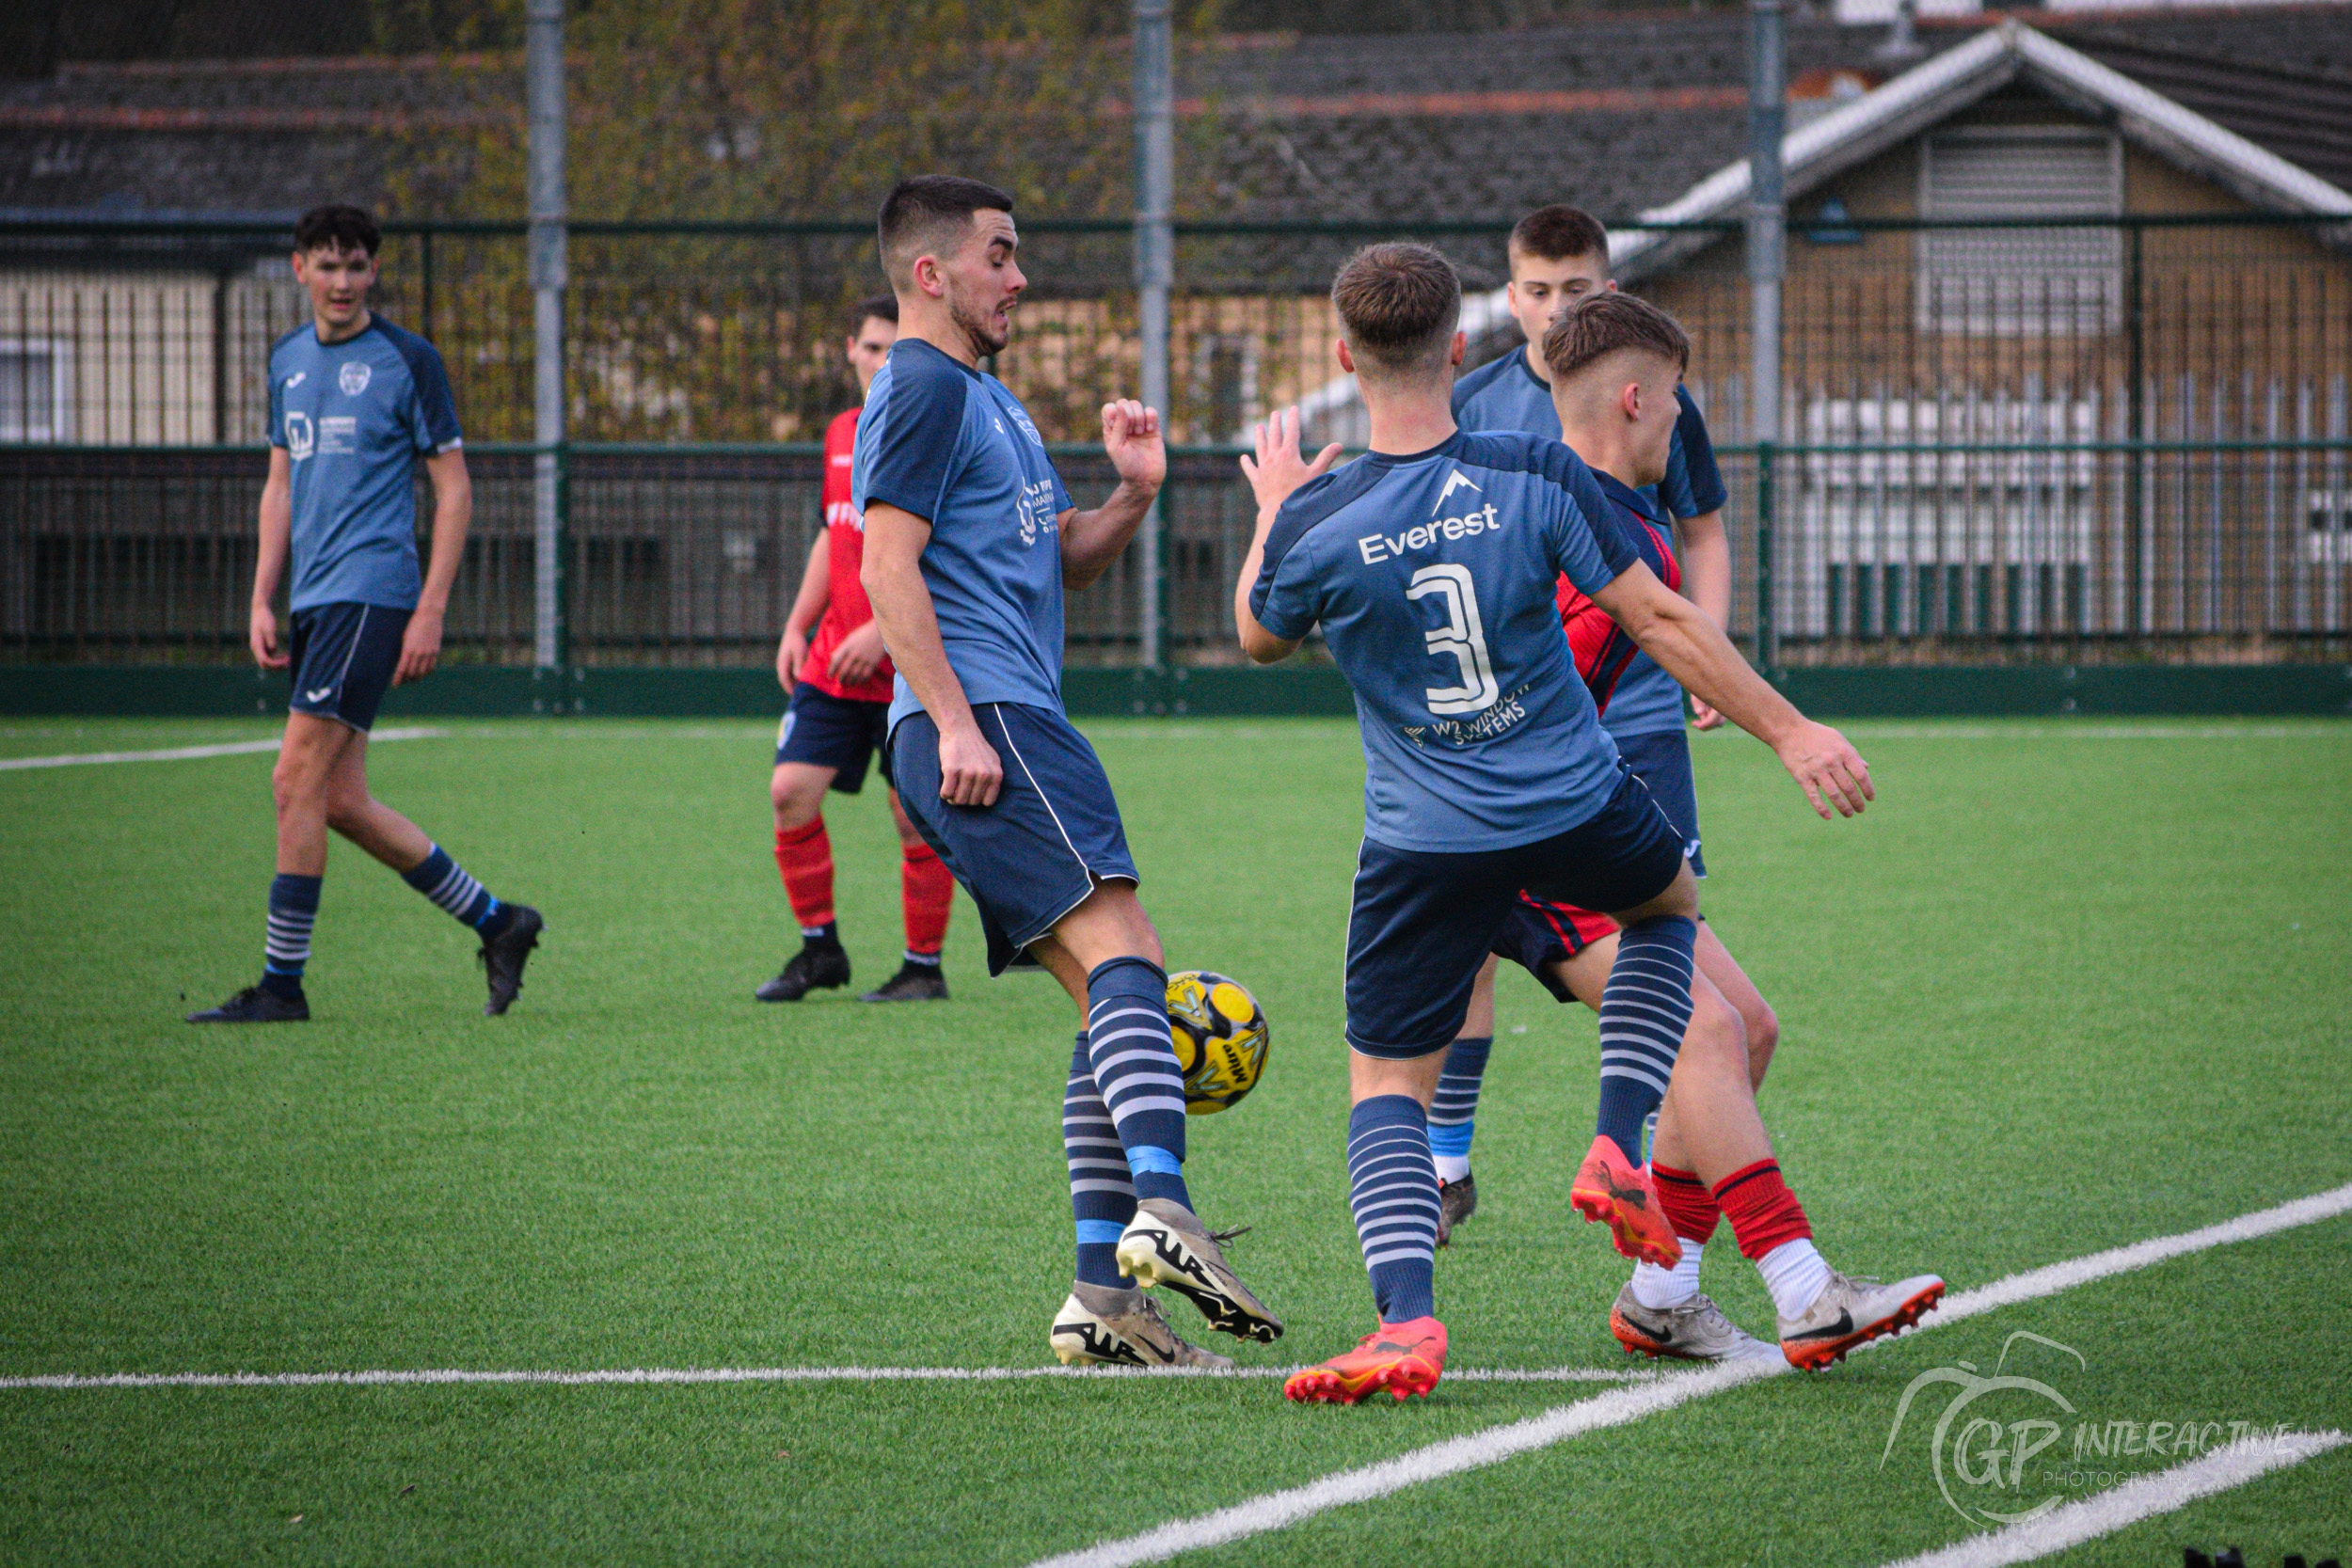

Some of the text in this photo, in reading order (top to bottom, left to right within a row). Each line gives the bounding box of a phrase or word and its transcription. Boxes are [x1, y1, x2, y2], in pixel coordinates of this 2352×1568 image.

[1359, 503, 1500, 565] Everest
[1406, 563, 1499, 715] 3
[1432, 721, 1462, 736] W2
